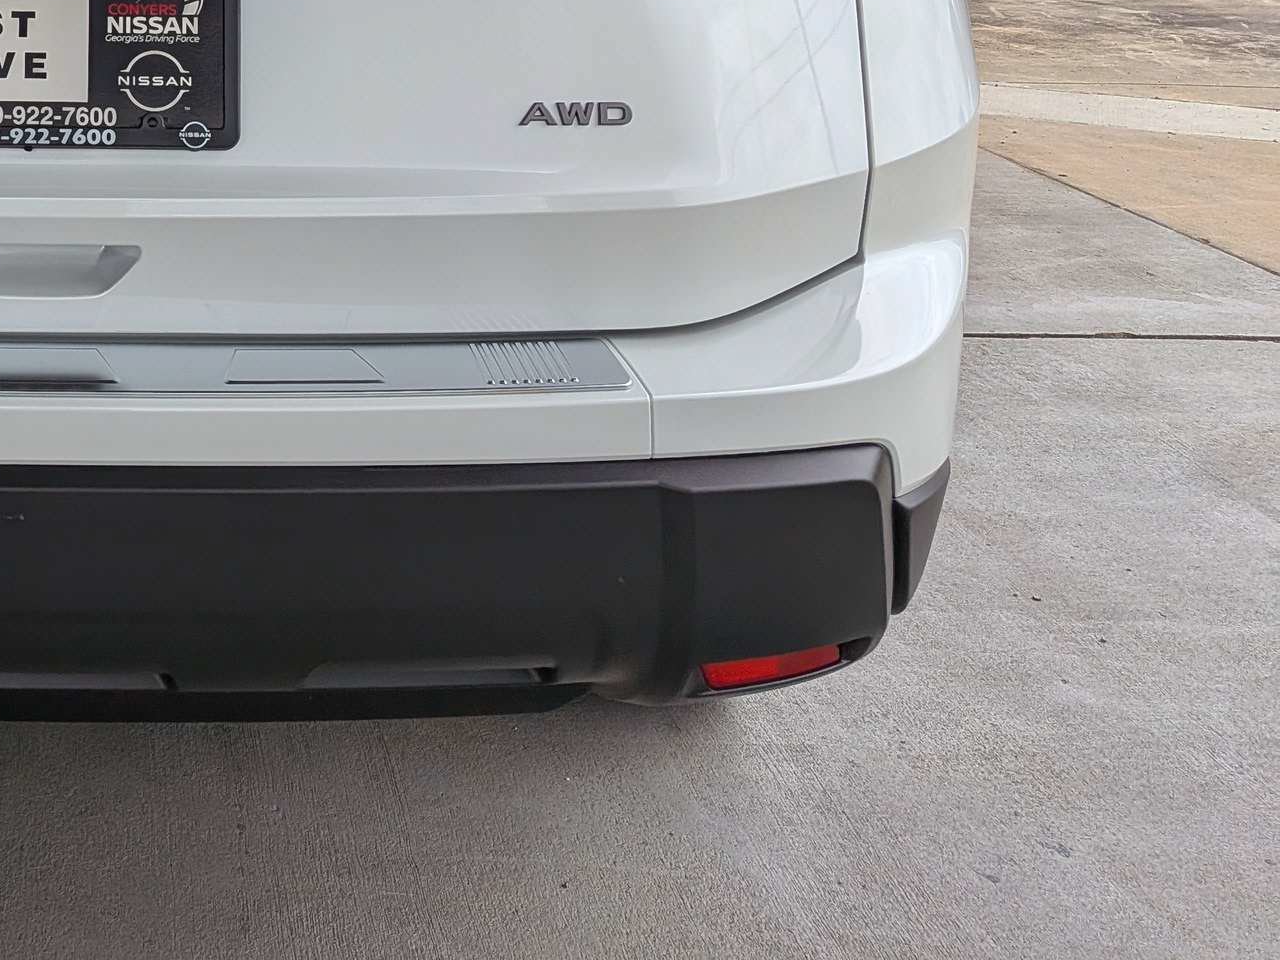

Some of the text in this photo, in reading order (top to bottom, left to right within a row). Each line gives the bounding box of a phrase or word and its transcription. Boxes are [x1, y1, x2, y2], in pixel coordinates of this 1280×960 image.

[107, 3, 177, 16] CONYERS
[106, 16, 199, 35] NISSAN
[104, 34, 201, 45] Georgia's Driving Force
[117, 75, 193, 87] NISSAN
[517, 101, 634, 126] AWD
